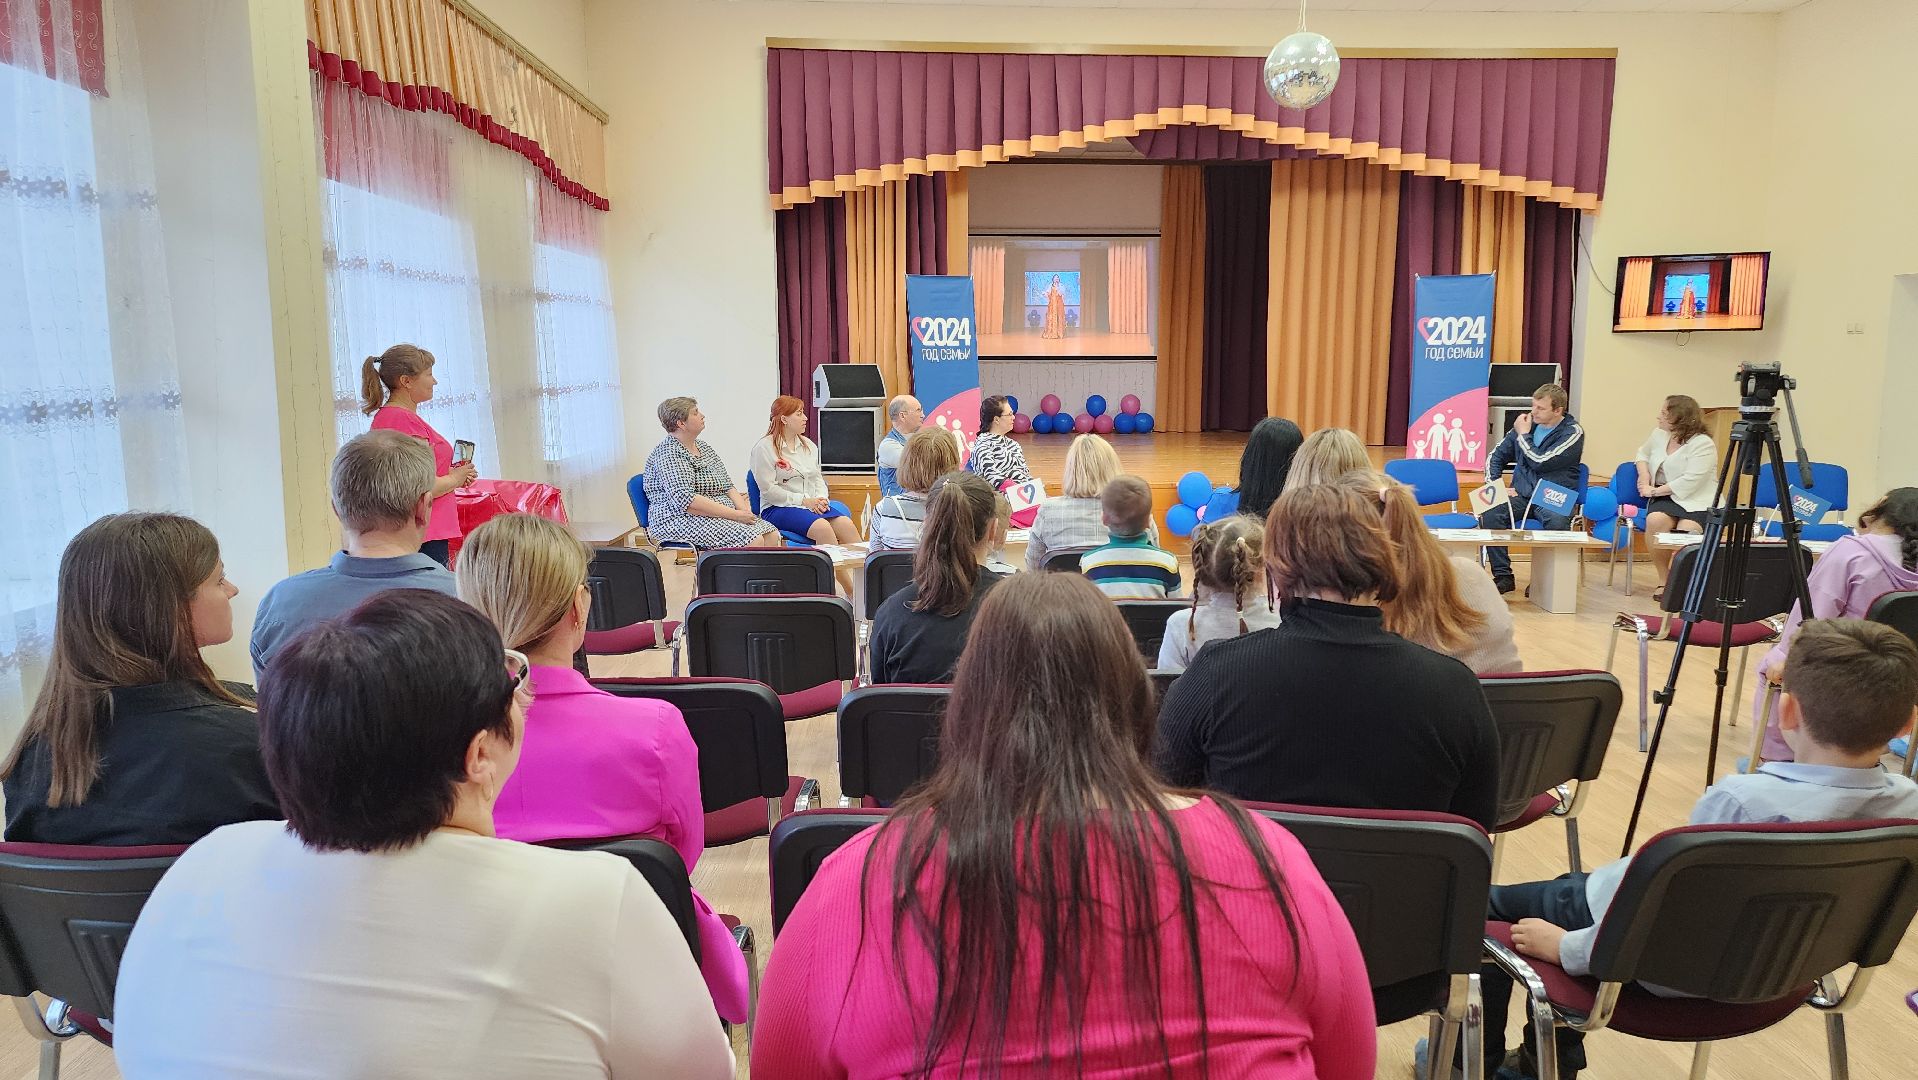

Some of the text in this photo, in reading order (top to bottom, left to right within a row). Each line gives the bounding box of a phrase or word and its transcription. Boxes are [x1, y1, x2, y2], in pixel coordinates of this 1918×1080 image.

[921, 317, 971, 346] 2024
[1426, 315, 1487, 346] 2024
[1545, 488, 1567, 503] 2024
[1794, 496, 1818, 513] 2024
